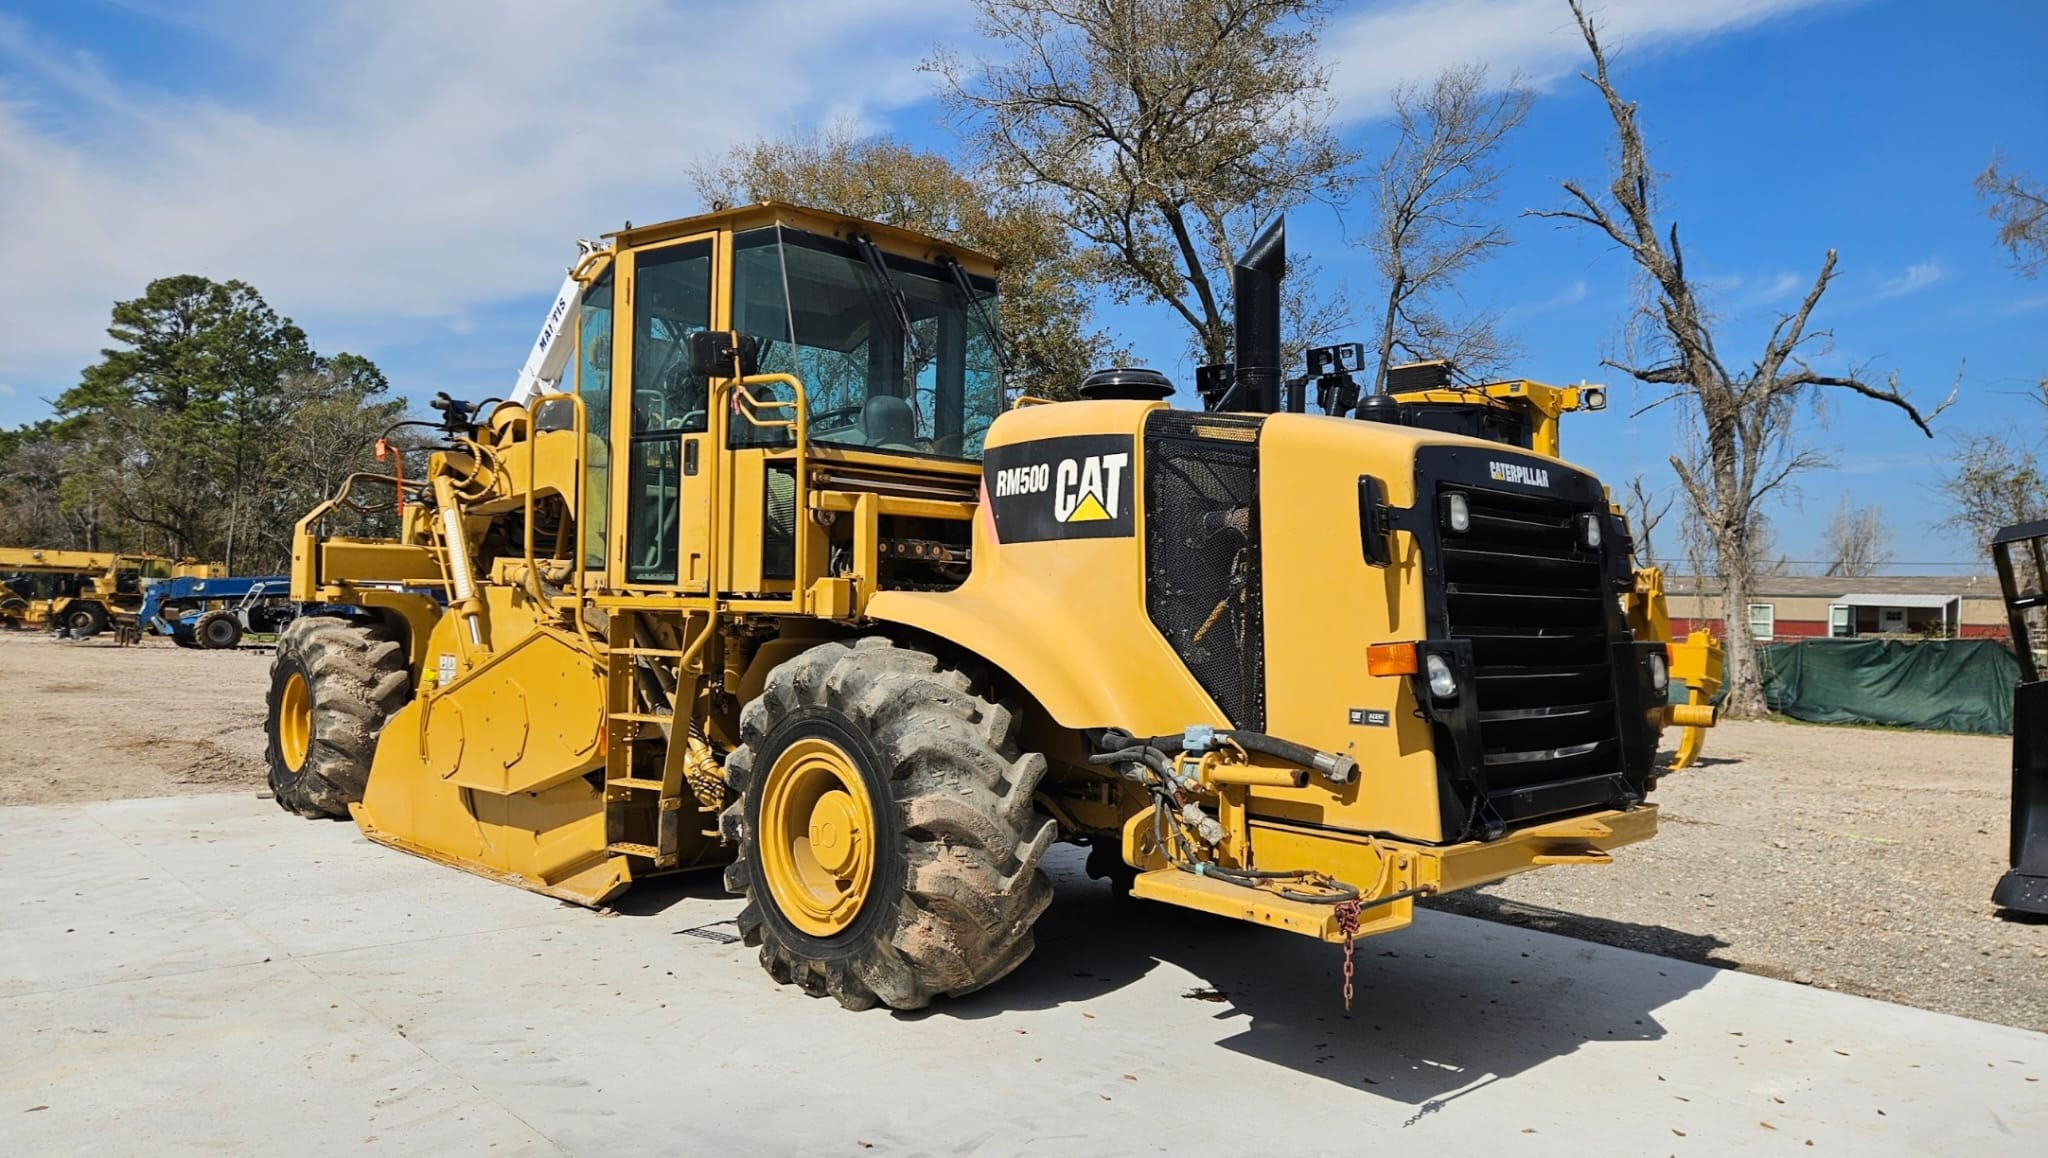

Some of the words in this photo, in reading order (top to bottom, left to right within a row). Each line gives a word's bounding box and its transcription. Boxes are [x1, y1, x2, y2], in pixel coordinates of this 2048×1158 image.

[996, 463, 1050, 497] RM500
[1054, 453, 1129, 523] CAT
[1489, 461, 1549, 488] CATERPILLAR
